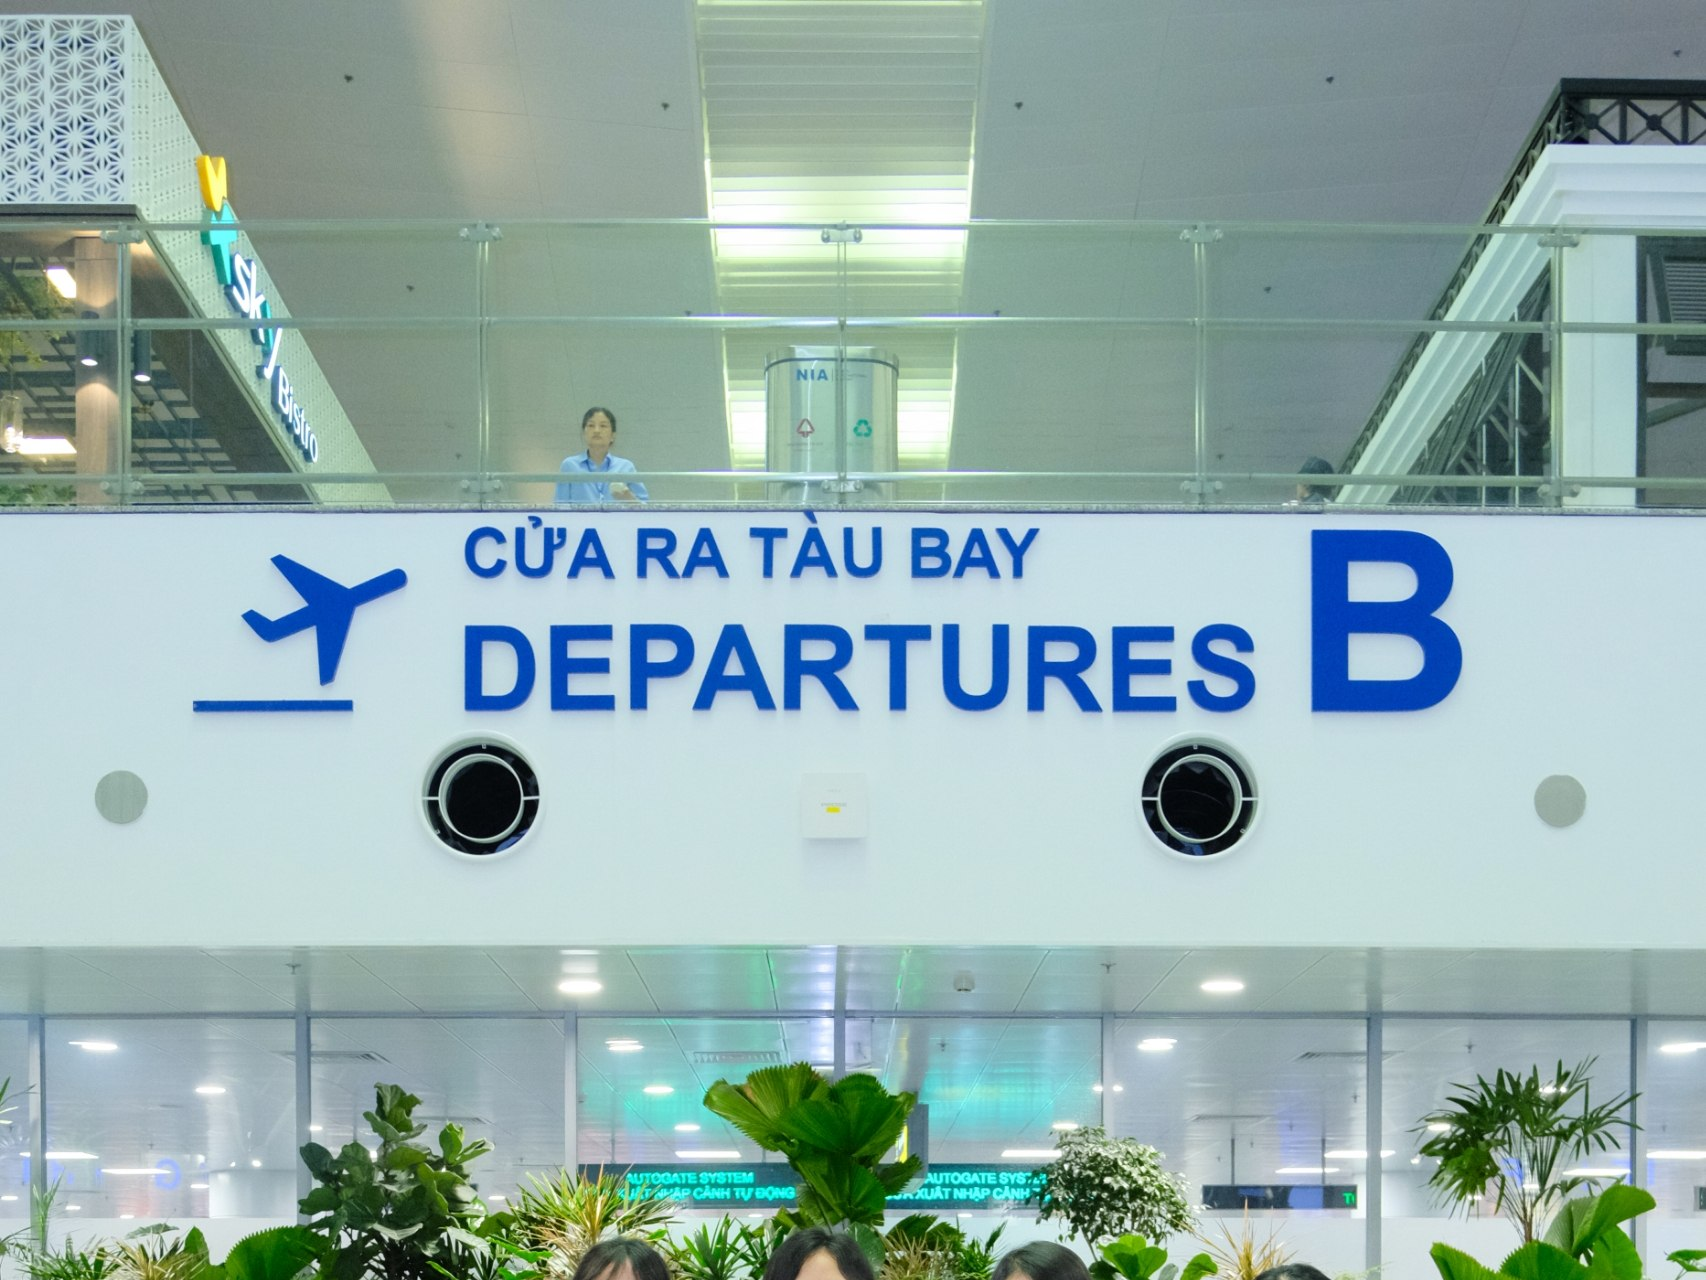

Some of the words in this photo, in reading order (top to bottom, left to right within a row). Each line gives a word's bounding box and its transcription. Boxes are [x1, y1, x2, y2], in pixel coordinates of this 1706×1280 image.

[232, 252, 283, 380] Sky
[278, 365, 319, 464] Bistro
[796, 368, 829, 381] NIA
[464, 515, 615, 580] CỬA
[636, 526, 730, 580] RA
[749, 511, 884, 580] TÀU
[910, 526, 1041, 580] BAY
[1310, 529, 1463, 714] B
[463, 623, 1256, 714] DEPARTURES
[626, 1172, 697, 1184] AUTOGATE
[698, 1172, 754, 1184] SYSTEM
[924, 1172, 997, 1185] AUTOGATE
[953, 1186, 991, 1202] NHẬP
